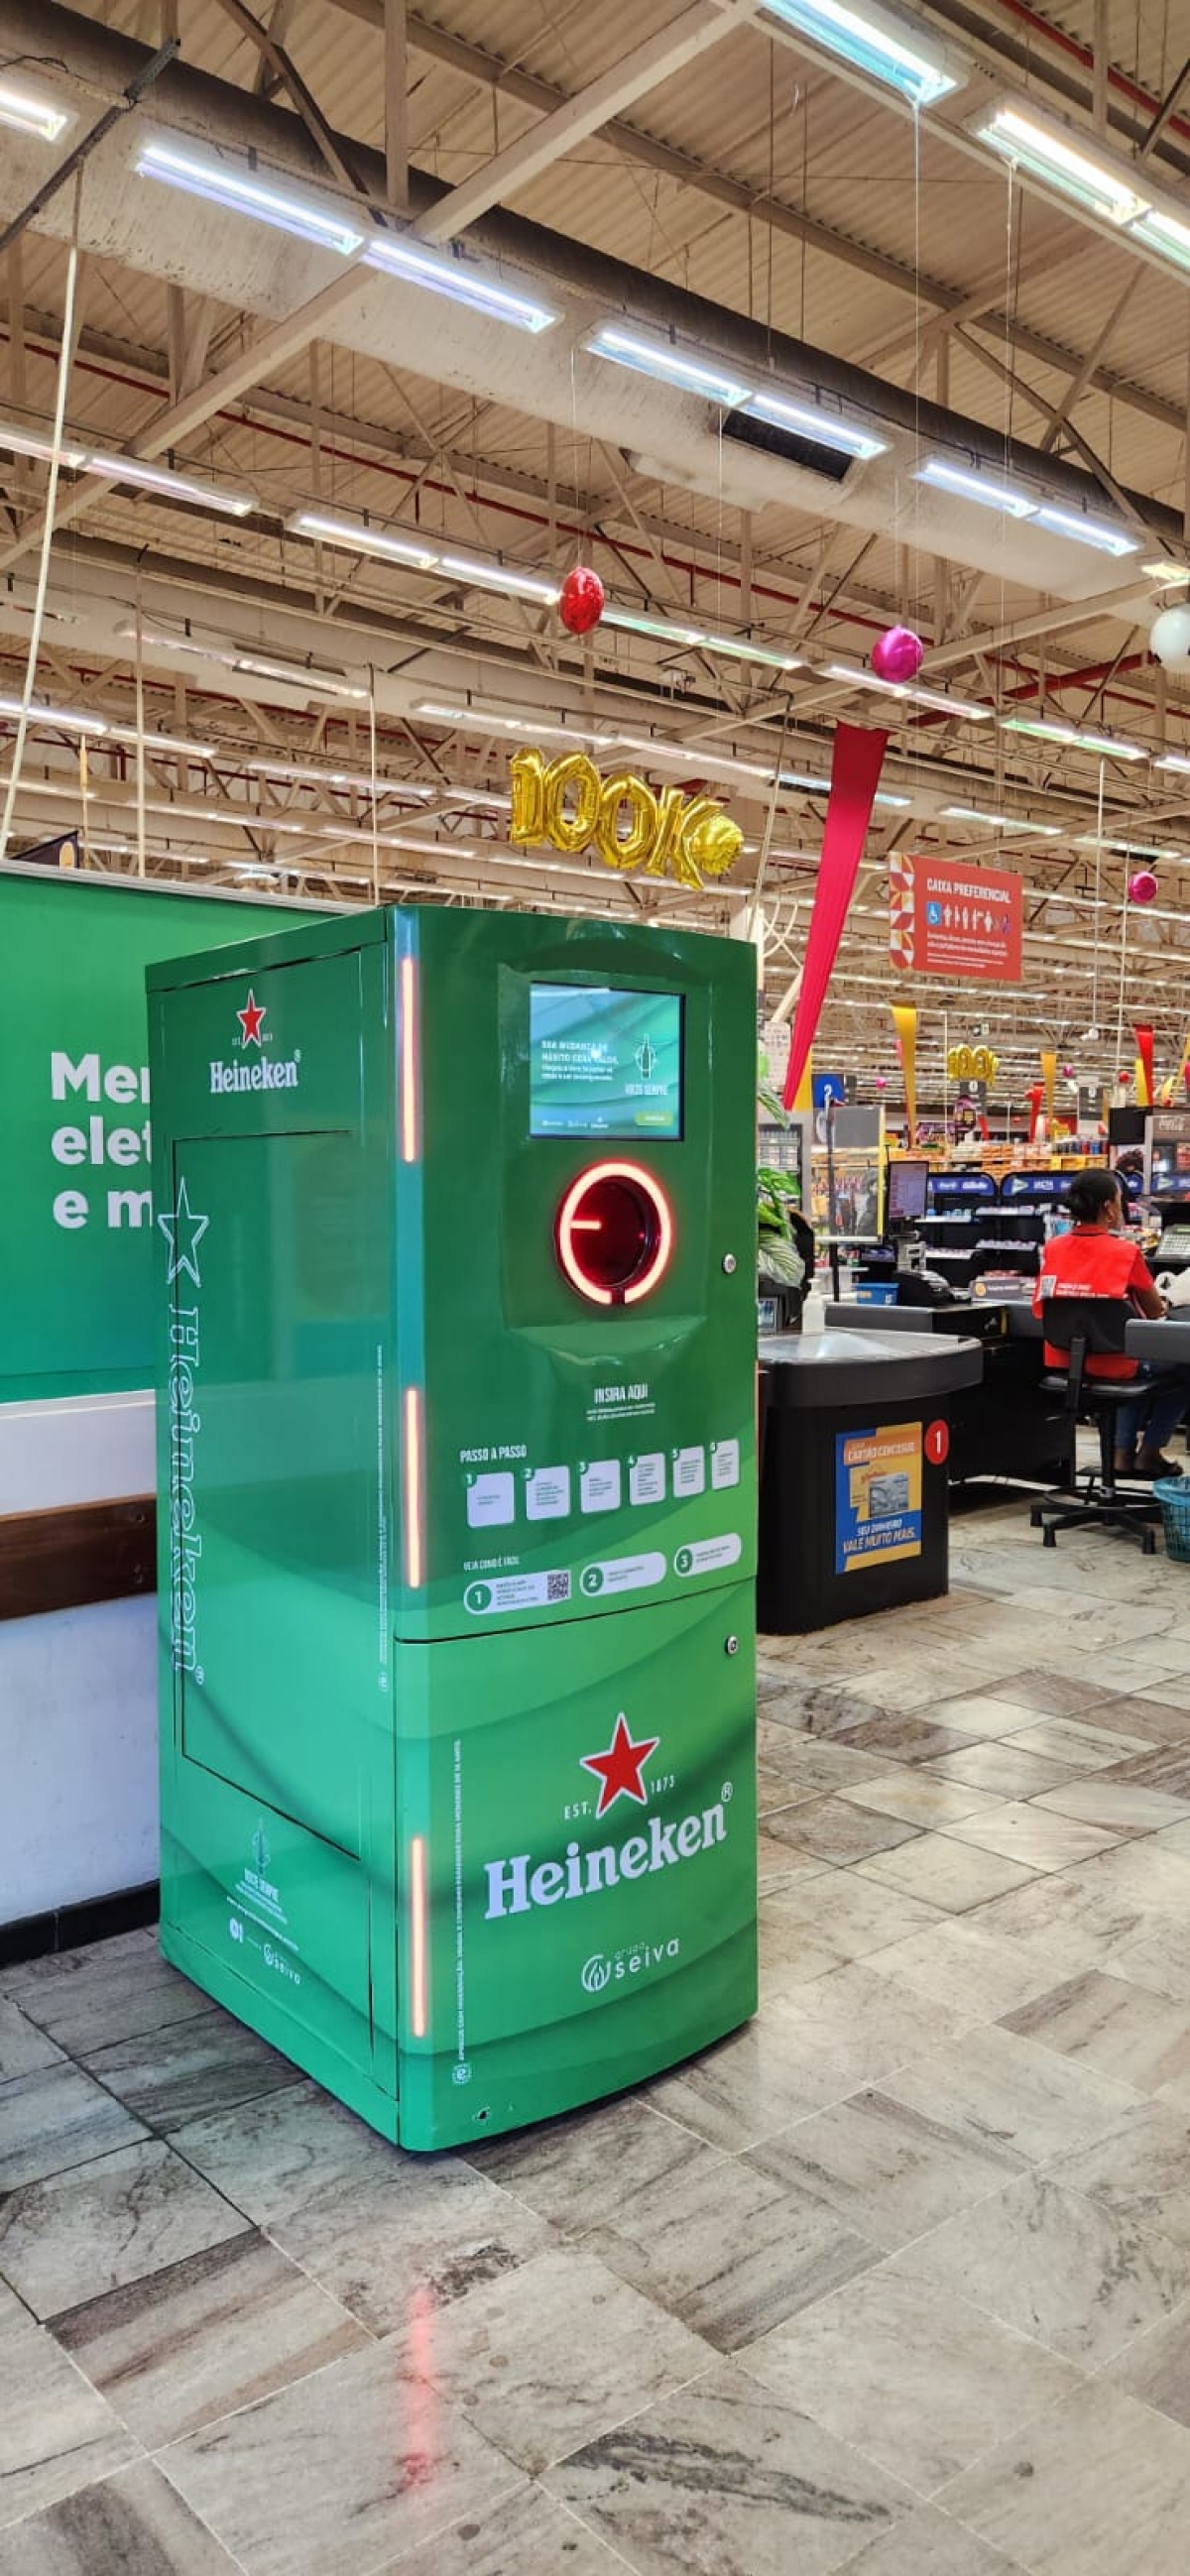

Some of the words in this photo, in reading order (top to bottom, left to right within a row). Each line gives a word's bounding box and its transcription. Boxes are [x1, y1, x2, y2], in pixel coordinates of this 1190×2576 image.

[927, 878, 951, 893] CAIXA
[53, 1190, 89, 1229] e
[594, 1386, 625, 1404] INSIRA
[628, 1382, 649, 1401] AQUI
[935, 1430, 942, 1455] 1
[459, 1448, 489, 1464] PASSO
[490, 1447, 497, 1461] A
[499, 1444, 528, 1460] PASSO
[466, 1472, 473, 1485] 1
[681, 1552, 689, 1568] 3
[588, 1574, 598, 1586] 2
[474, 1590, 483, 1605] 1
[564, 1802, 592, 1820] EST.
[483, 1804, 728, 1921] Heineken
[616, 1937, 680, 1979] seiva
